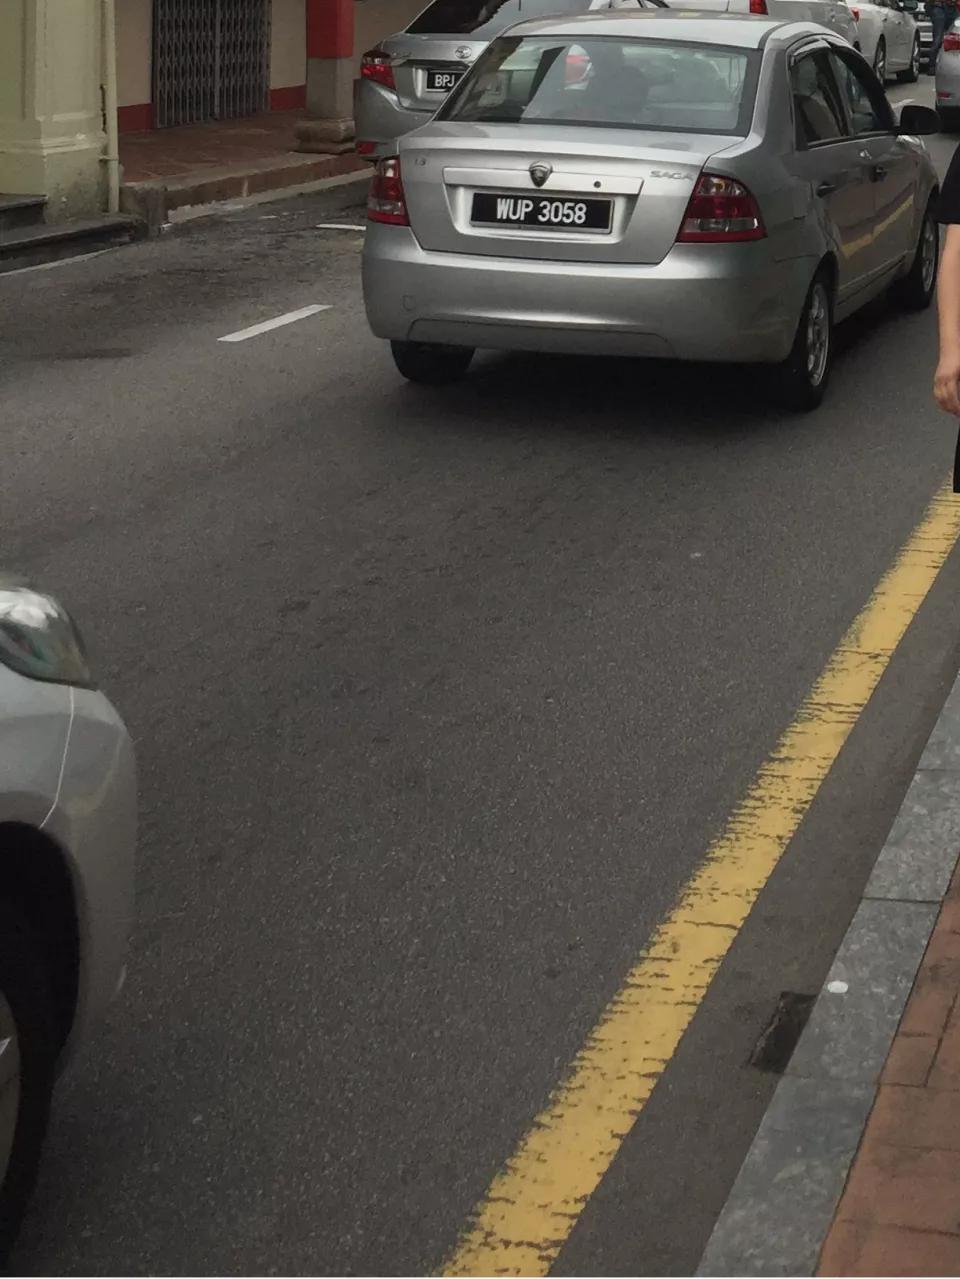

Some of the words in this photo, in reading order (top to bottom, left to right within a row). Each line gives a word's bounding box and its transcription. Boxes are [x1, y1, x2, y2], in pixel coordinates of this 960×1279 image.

[435, 74, 455, 87] BPJ
[496, 198, 533, 220] WUP
[537, 201, 587, 224] 3058
